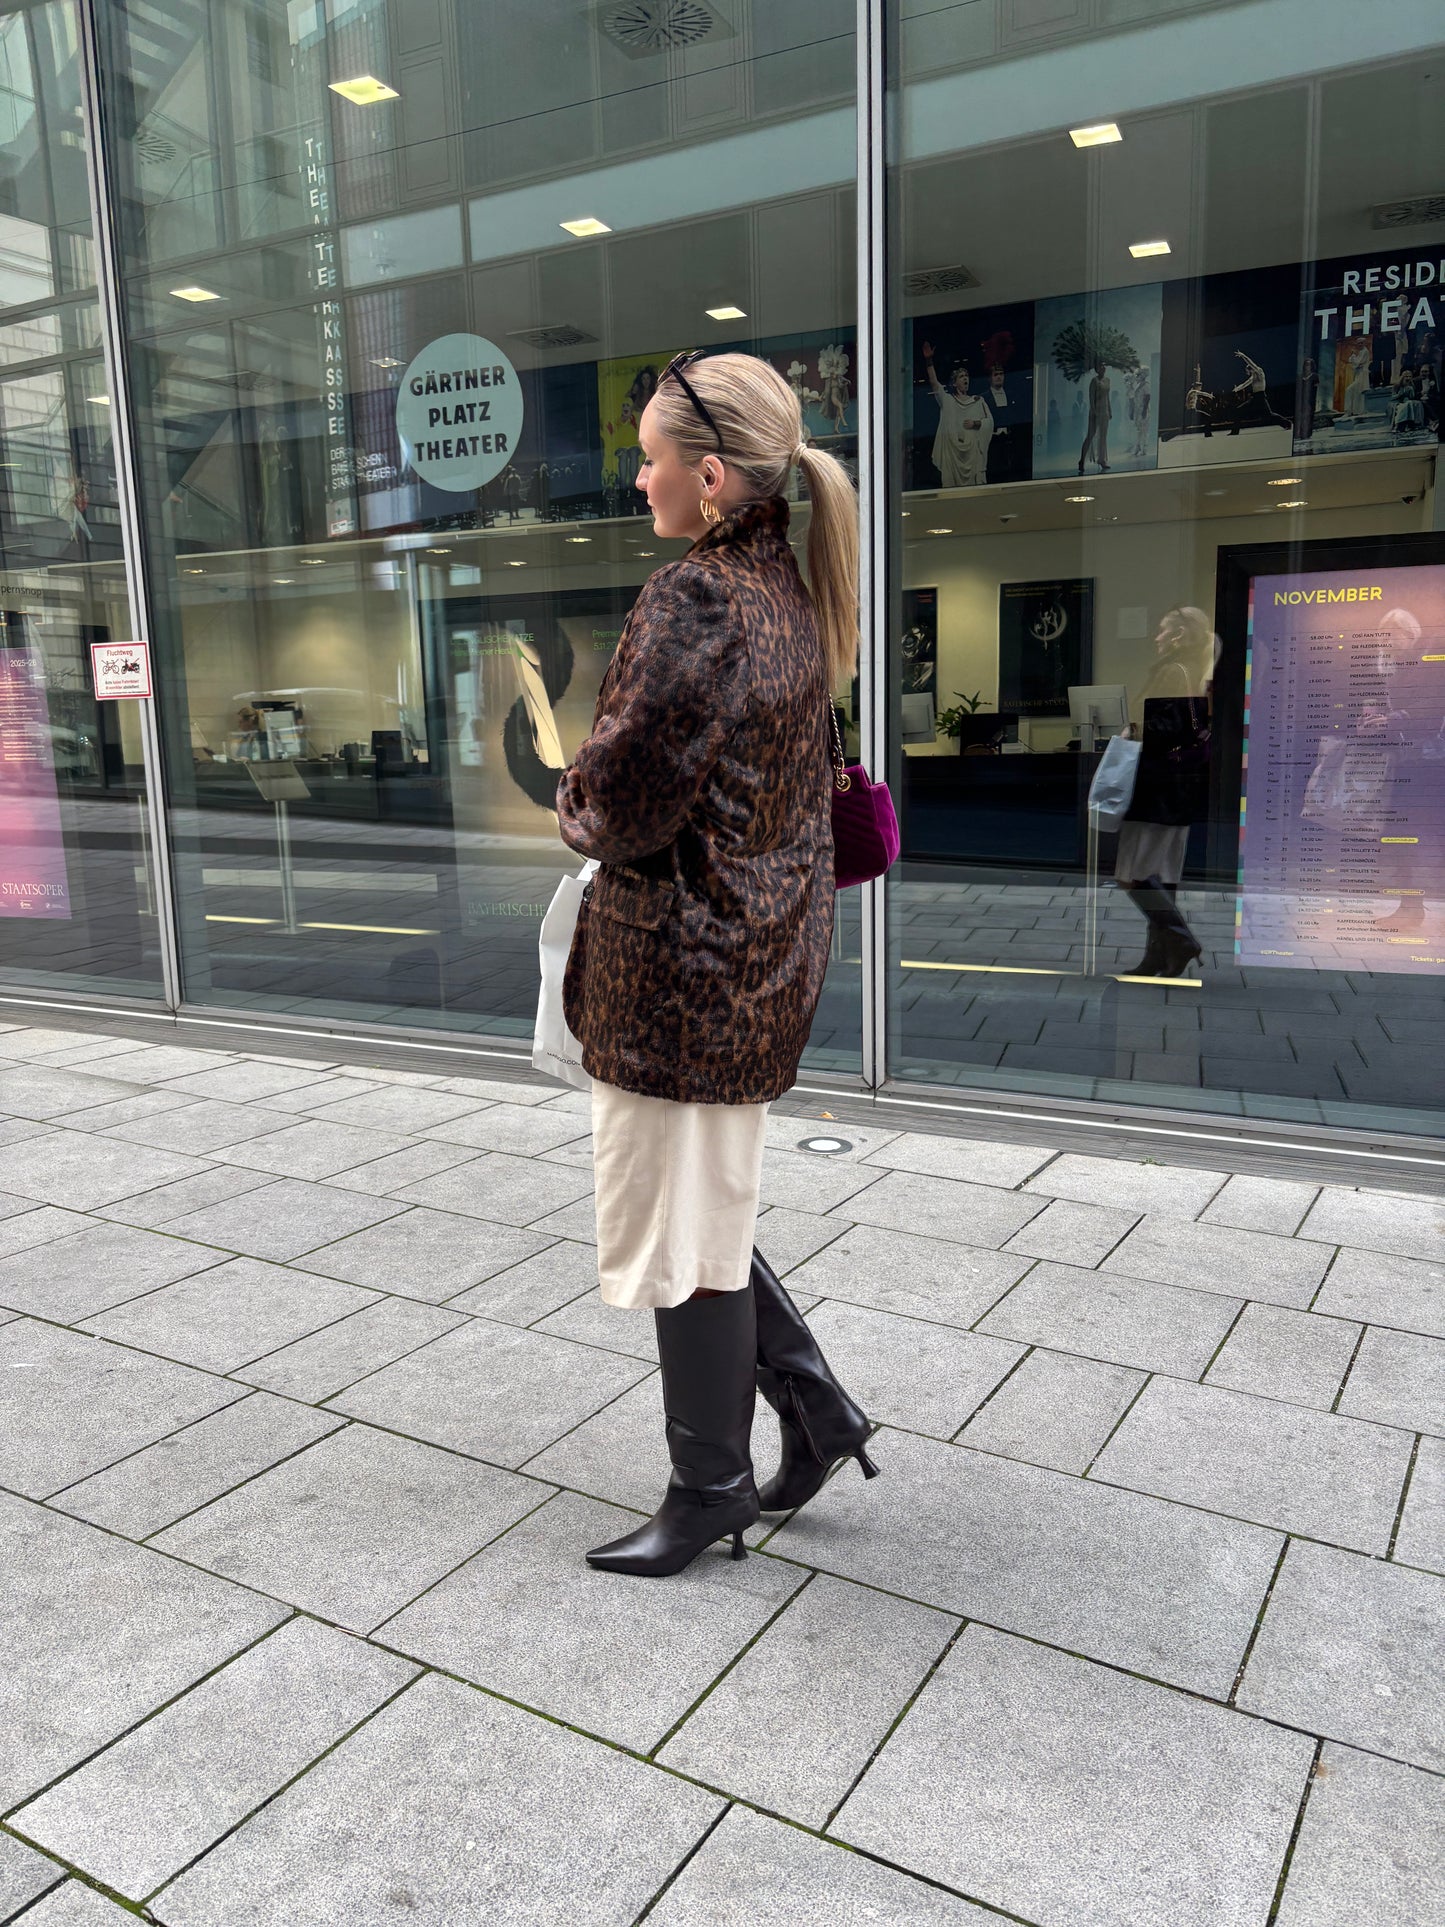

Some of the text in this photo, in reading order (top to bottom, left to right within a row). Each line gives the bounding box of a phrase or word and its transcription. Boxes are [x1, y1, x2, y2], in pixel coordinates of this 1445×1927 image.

[1314, 295, 1445, 340] THEA
[409, 365, 506, 397] GÄRTNER
[428, 401, 491, 428] PLATZ
[414, 433, 508, 462] THEATER
[1274, 586, 1383, 606] NOVEMBER
[1, 882, 65, 896] STAATSOPER
